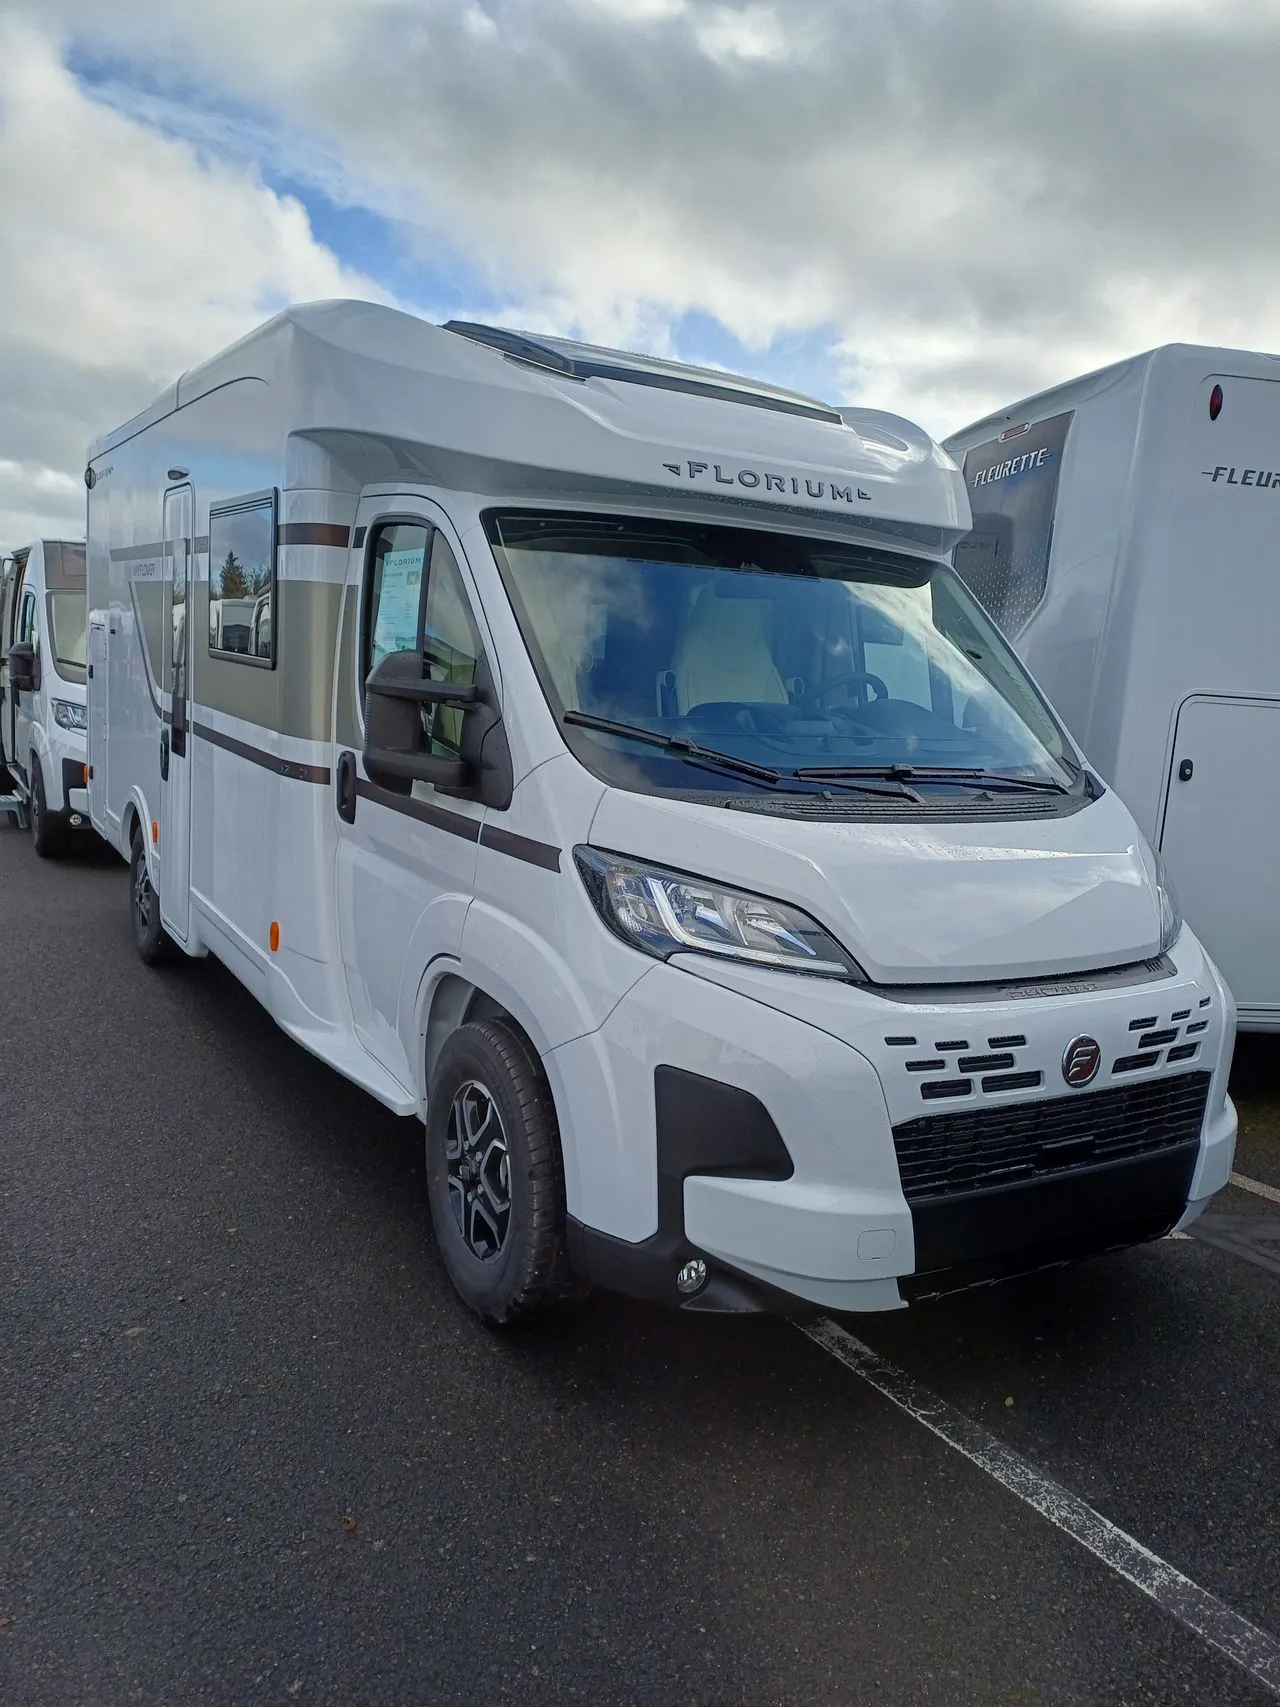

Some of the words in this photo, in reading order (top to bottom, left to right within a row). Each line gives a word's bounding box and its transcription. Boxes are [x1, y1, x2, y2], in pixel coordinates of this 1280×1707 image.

[687, 460, 853, 503] FLORIUM
[973, 447, 1049, 488] FLEURETTE
[1211, 465, 1280, 489] FLEUR
